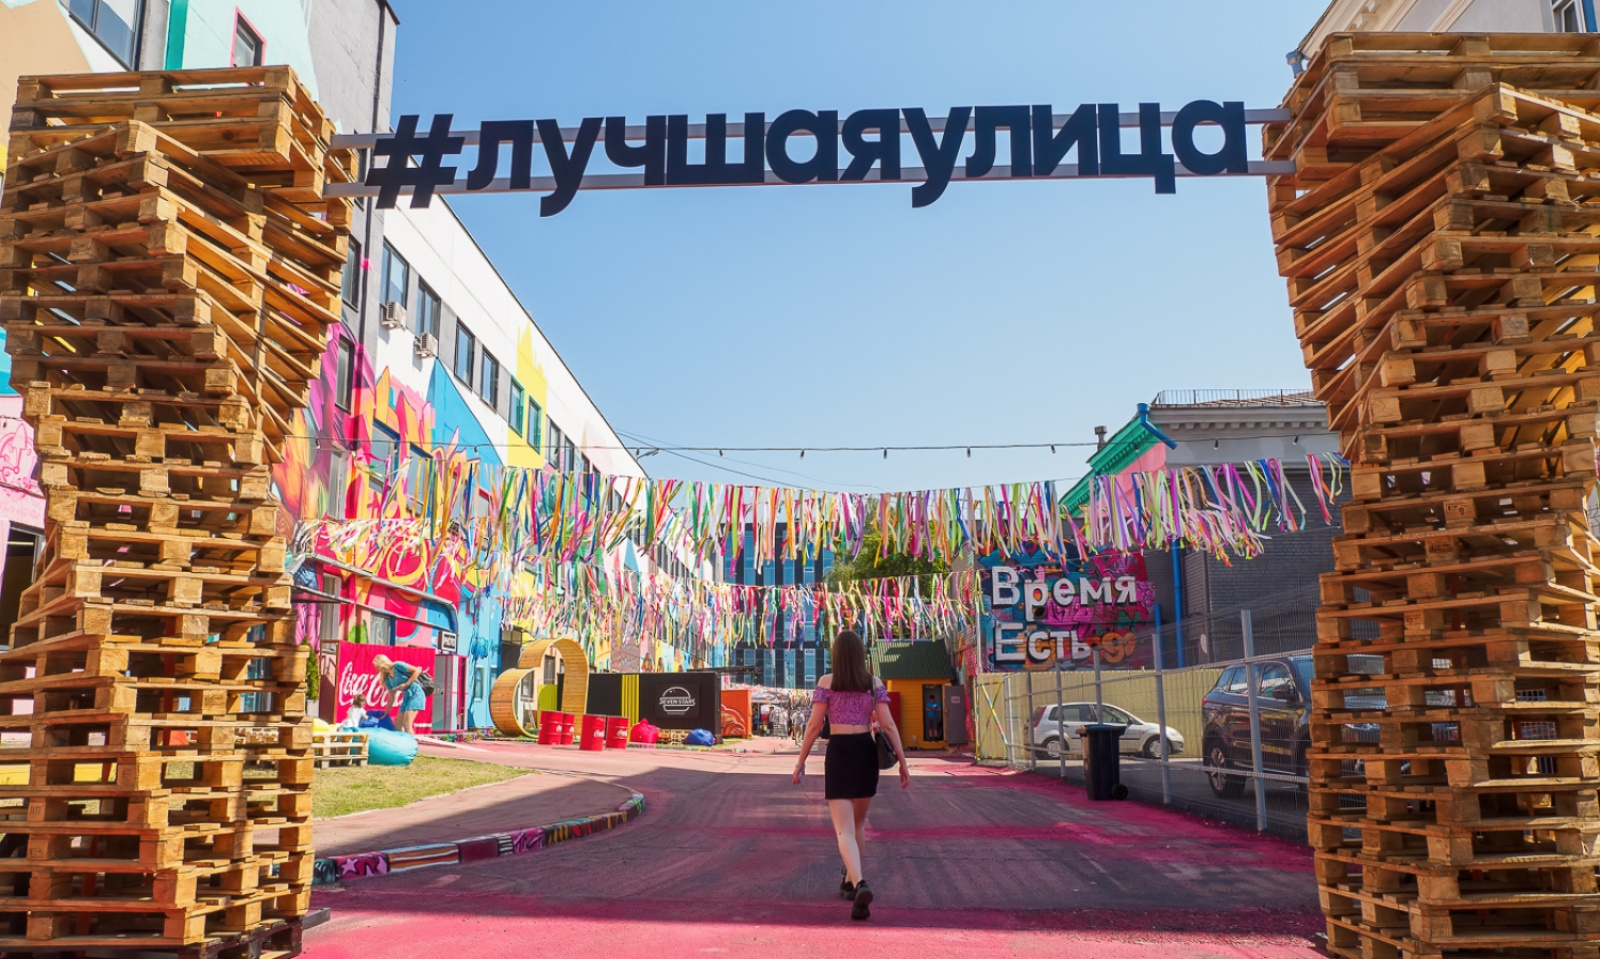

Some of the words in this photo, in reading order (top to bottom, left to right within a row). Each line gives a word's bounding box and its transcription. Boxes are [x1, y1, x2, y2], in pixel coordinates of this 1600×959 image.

[364, 99, 1249, 218] #лучшаяулица
[991, 565, 1138, 622] Время
[994, 621, 1092, 662] Есть
